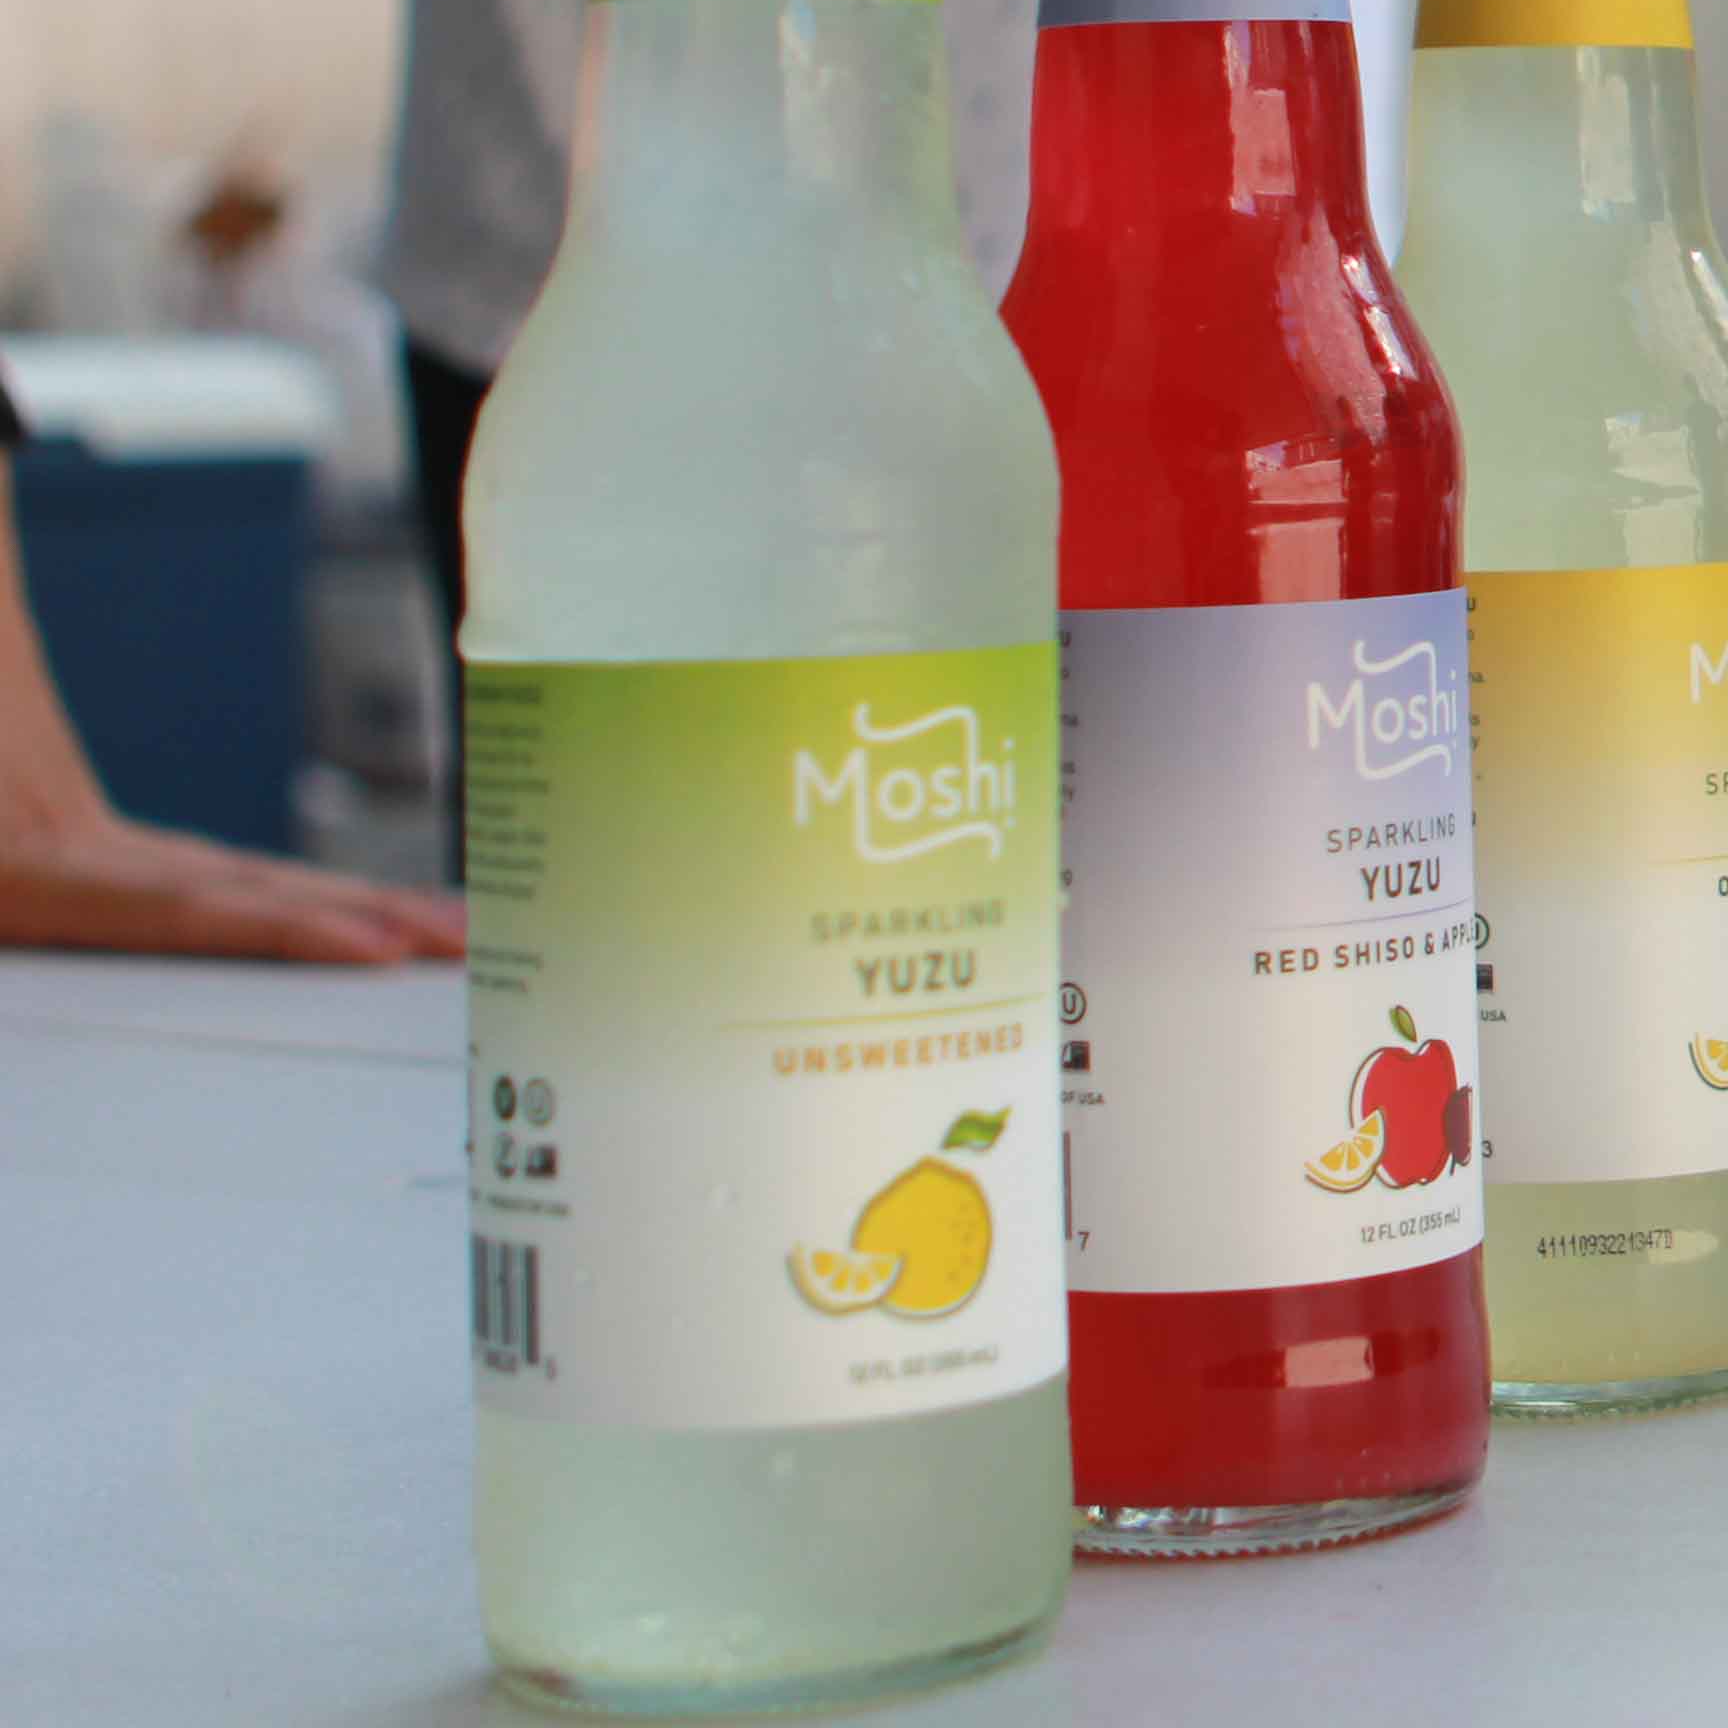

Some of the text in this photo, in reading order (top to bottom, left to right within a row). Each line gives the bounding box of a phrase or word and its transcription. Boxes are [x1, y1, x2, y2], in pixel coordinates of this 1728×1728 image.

[1306, 640, 1457, 781] Moshi
[793, 702, 1018, 864] Moshi
[1326, 812, 1457, 854] SPARKLING
[1361, 856, 1442, 901] YUZU
[811, 898, 1006, 941] SPARKLING
[855, 950, 977, 997] YUZU
[1254, 947, 1320, 975] RED
[1333, 935, 1416, 969] SHISO
[1423, 931, 1436, 955] &
[773, 1023, 1024, 1073] UNSWEETENED
[1360, 1226, 1375, 1244] 12
[1378, 1222, 1398, 1241] FL
[1400, 1216, 1418, 1236] OZ
